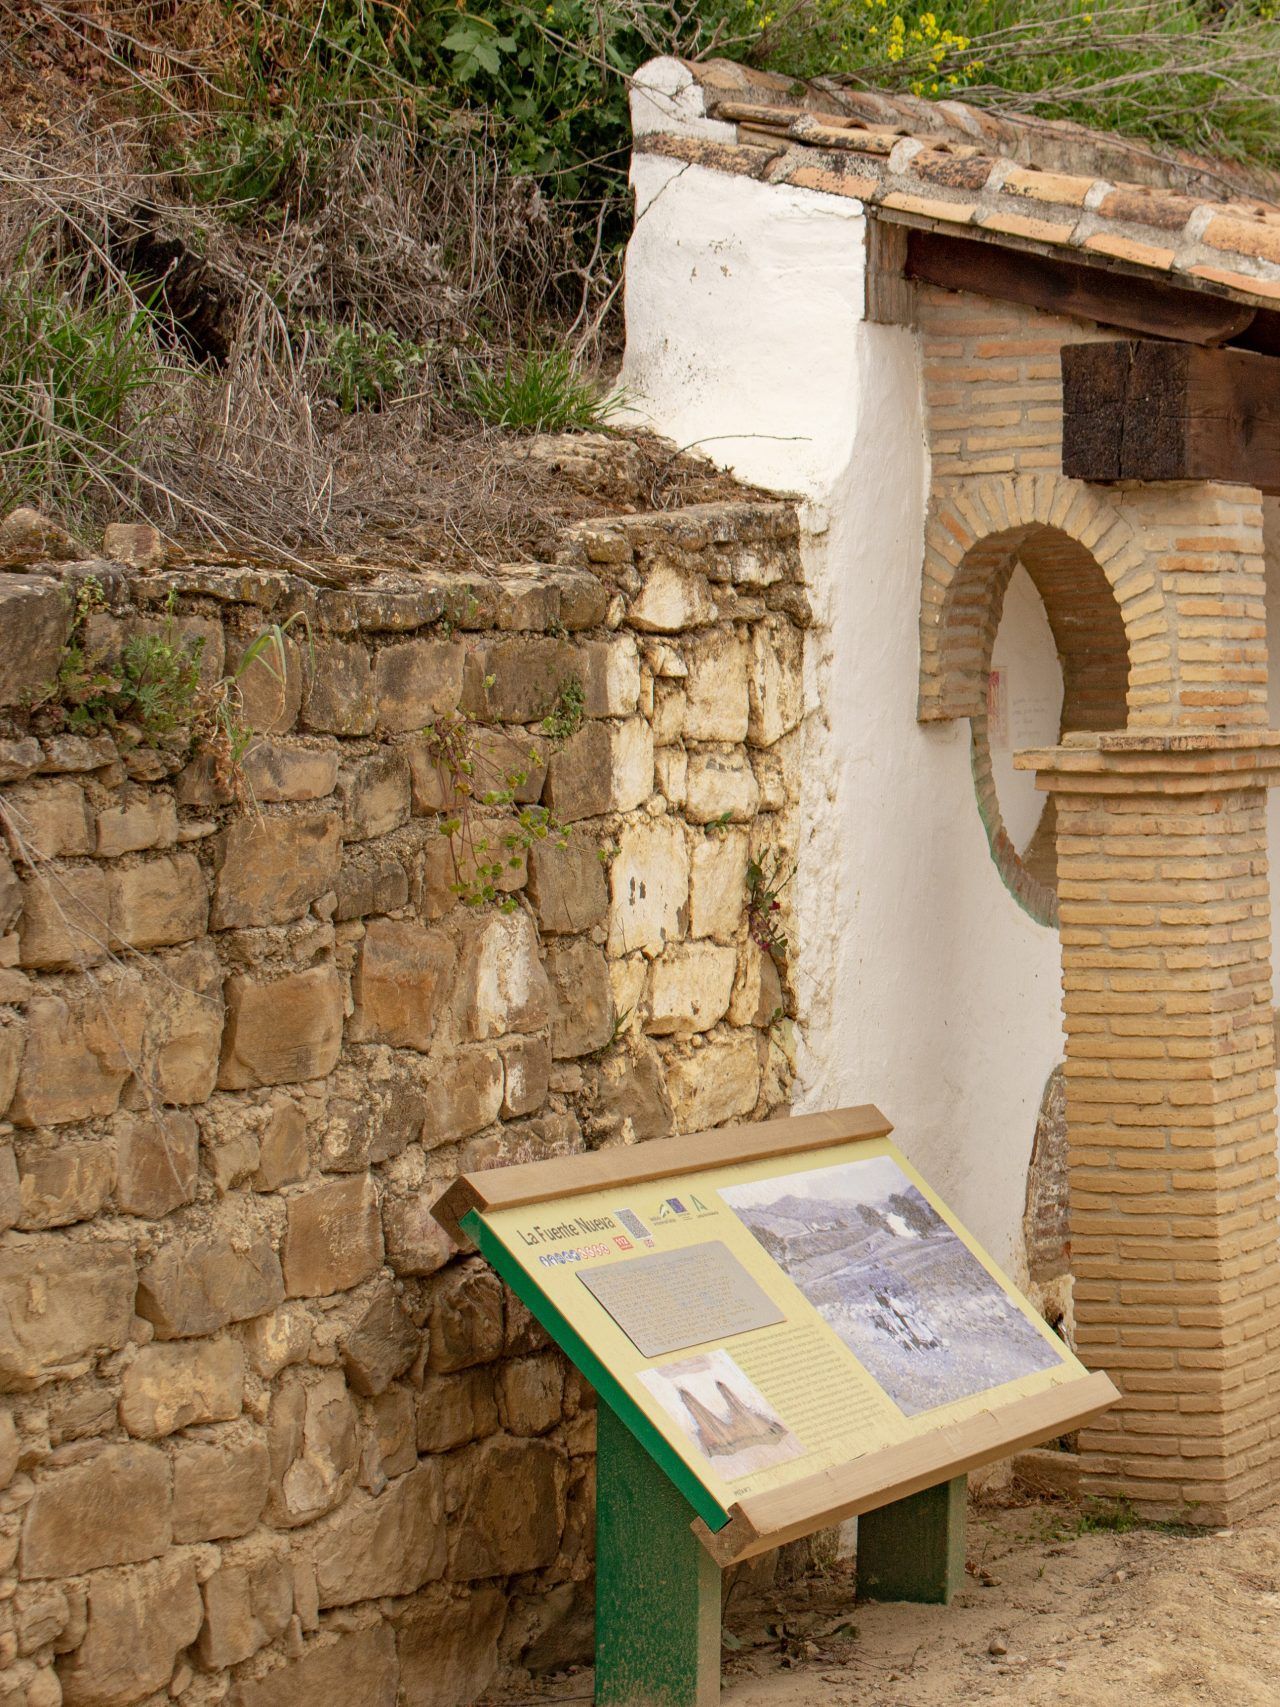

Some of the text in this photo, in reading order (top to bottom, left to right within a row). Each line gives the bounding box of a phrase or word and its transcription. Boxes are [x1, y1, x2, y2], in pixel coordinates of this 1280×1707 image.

[517, 1216, 616, 1246] La Fuente Nueva
